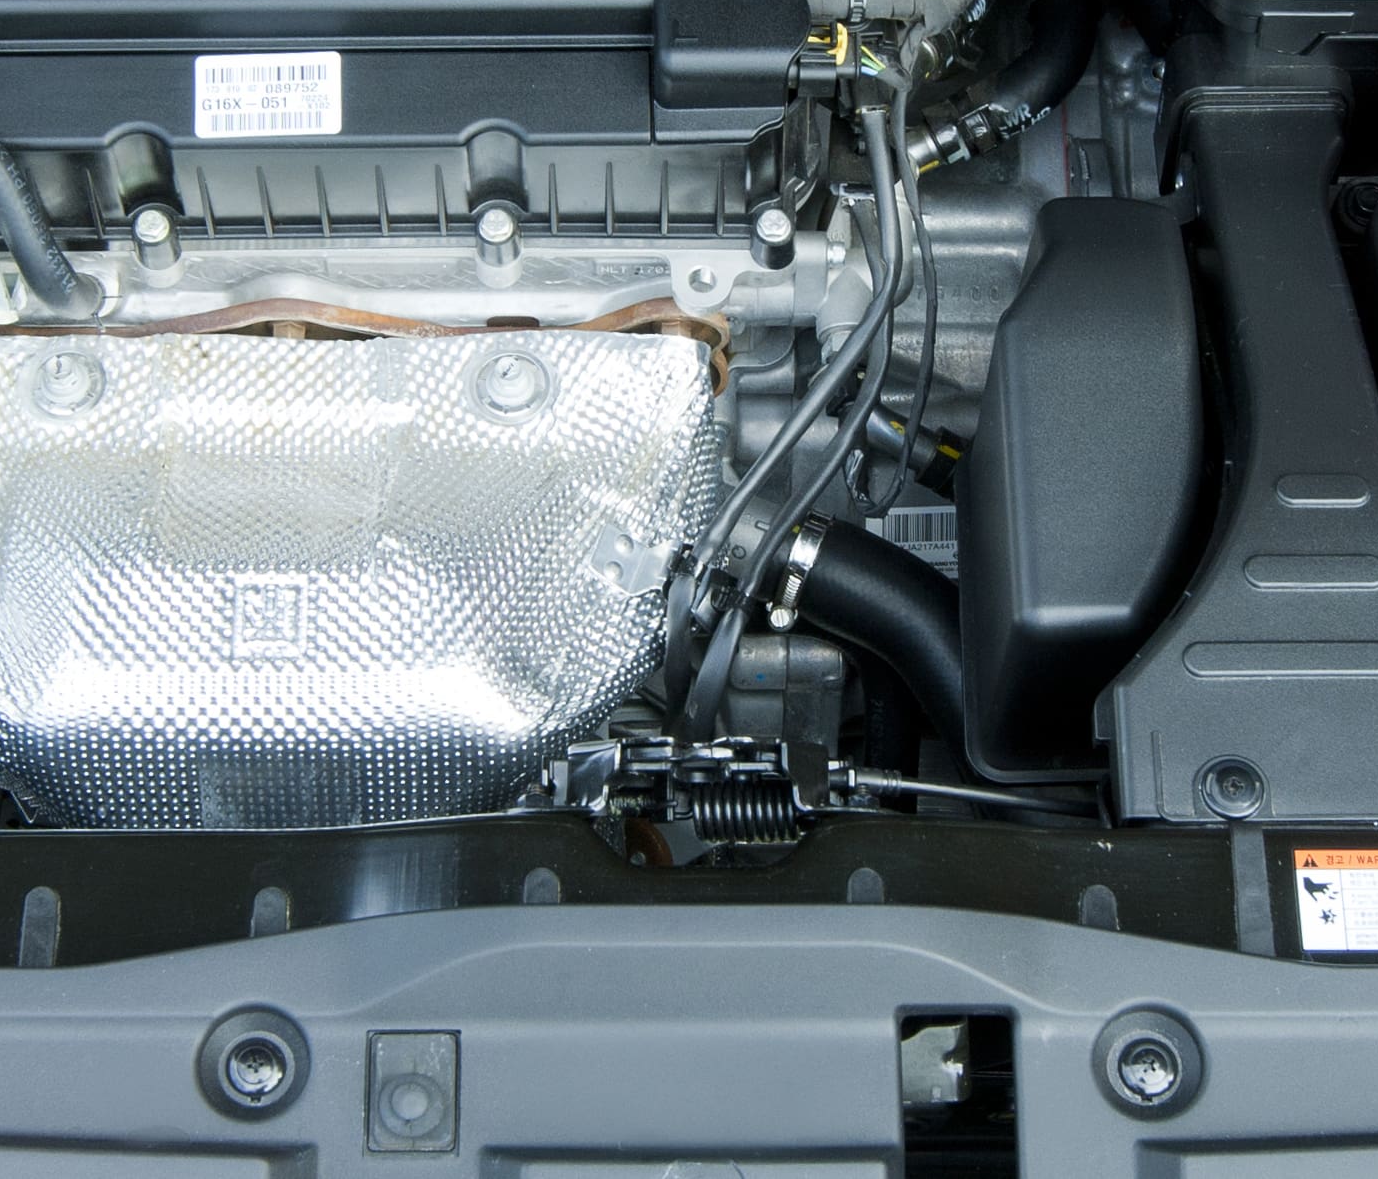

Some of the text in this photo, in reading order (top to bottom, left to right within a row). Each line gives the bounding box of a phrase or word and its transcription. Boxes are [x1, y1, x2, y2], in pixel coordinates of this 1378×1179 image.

[265, 82, 319, 94] 089752
[6, 162, 26, 191] PH
[1325, 854, 1345, 866] 경고
